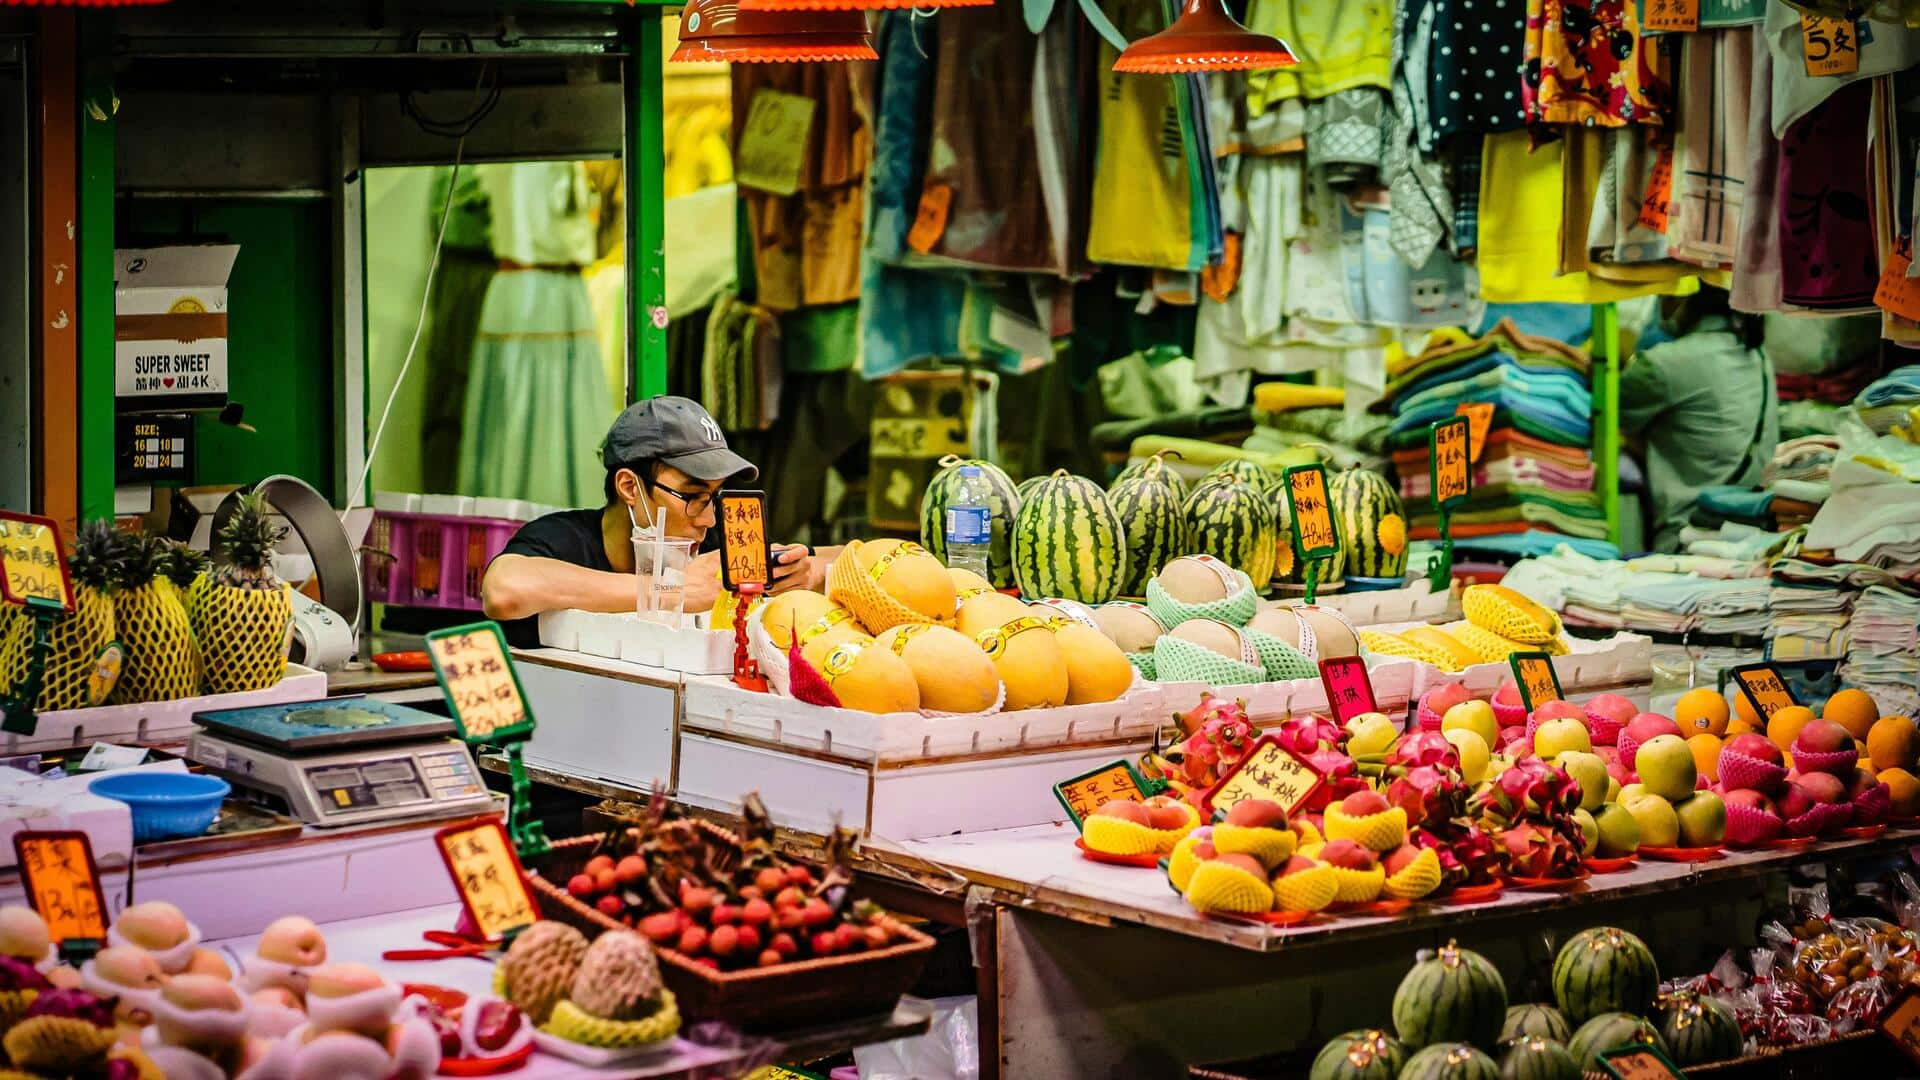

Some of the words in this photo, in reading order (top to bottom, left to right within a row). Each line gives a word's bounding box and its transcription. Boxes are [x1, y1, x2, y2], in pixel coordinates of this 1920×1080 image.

[135, 355, 171, 374] SUPER
[174, 353, 210, 373] SWEET
[1006, 621, 1025, 634] SK
